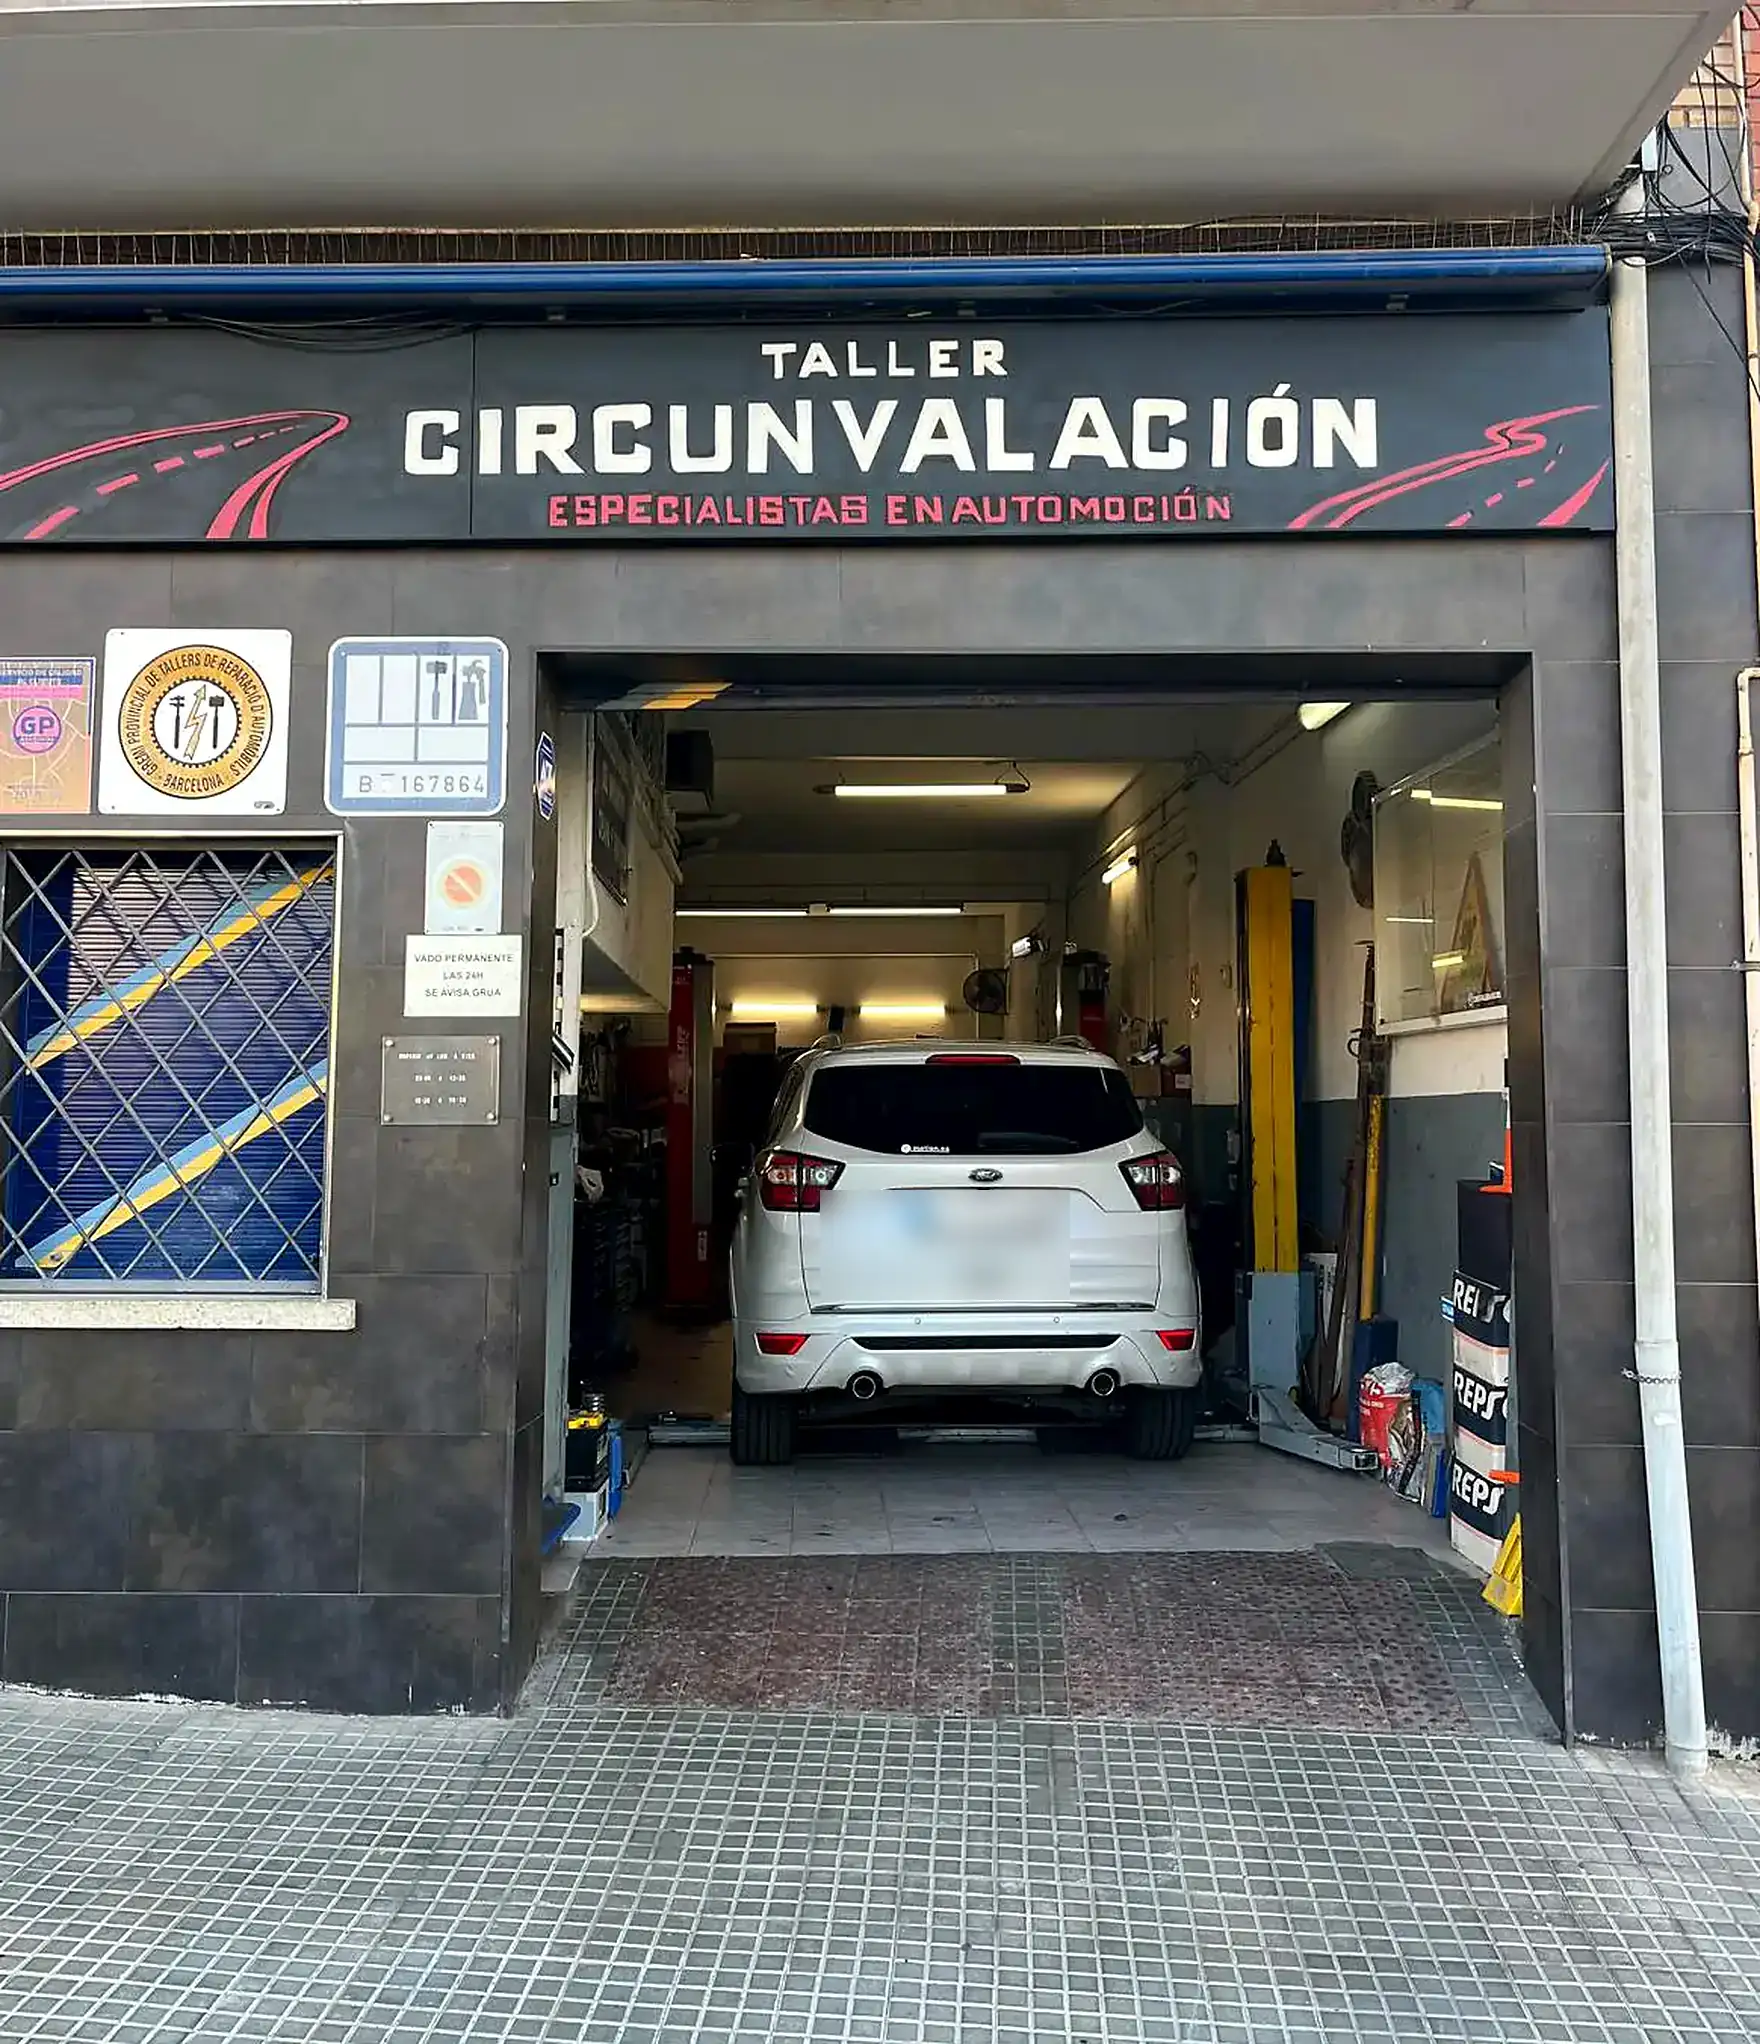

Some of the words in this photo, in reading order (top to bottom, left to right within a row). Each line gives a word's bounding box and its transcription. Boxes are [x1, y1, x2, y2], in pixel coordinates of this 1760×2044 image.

[762, 340, 1007, 379] TALLER
[405, 384, 1378, 476] CIRCUNVALACIÓN
[548, 494, 869, 527] ESPECIALISTAS
[886, 495, 943, 525] EN
[951, 487, 1231, 524] AUTOMOCIÓN
[158, 653, 201, 674] TALLERS
[203, 653, 219, 668] DE
[144, 672, 161, 688] DE
[21, 716, 55, 734] GP
[125, 686, 151, 745] PROVINCIAL
[131, 745, 158, 776] GREMI
[163, 773, 225, 793] BARCELONA
[402, 775, 484, 793] 167864
[414, 953, 443, 963] VADO
[445, 953, 514, 963] PERMANENTE
[443, 971, 462, 981] LAS
[465, 971, 484, 981] 24H
[425, 988, 438, 997] SE
[440, 988, 470, 997] AVISA
[472, 988, 501, 997] GRUA
[1453, 1370, 1508, 1421] REPS
